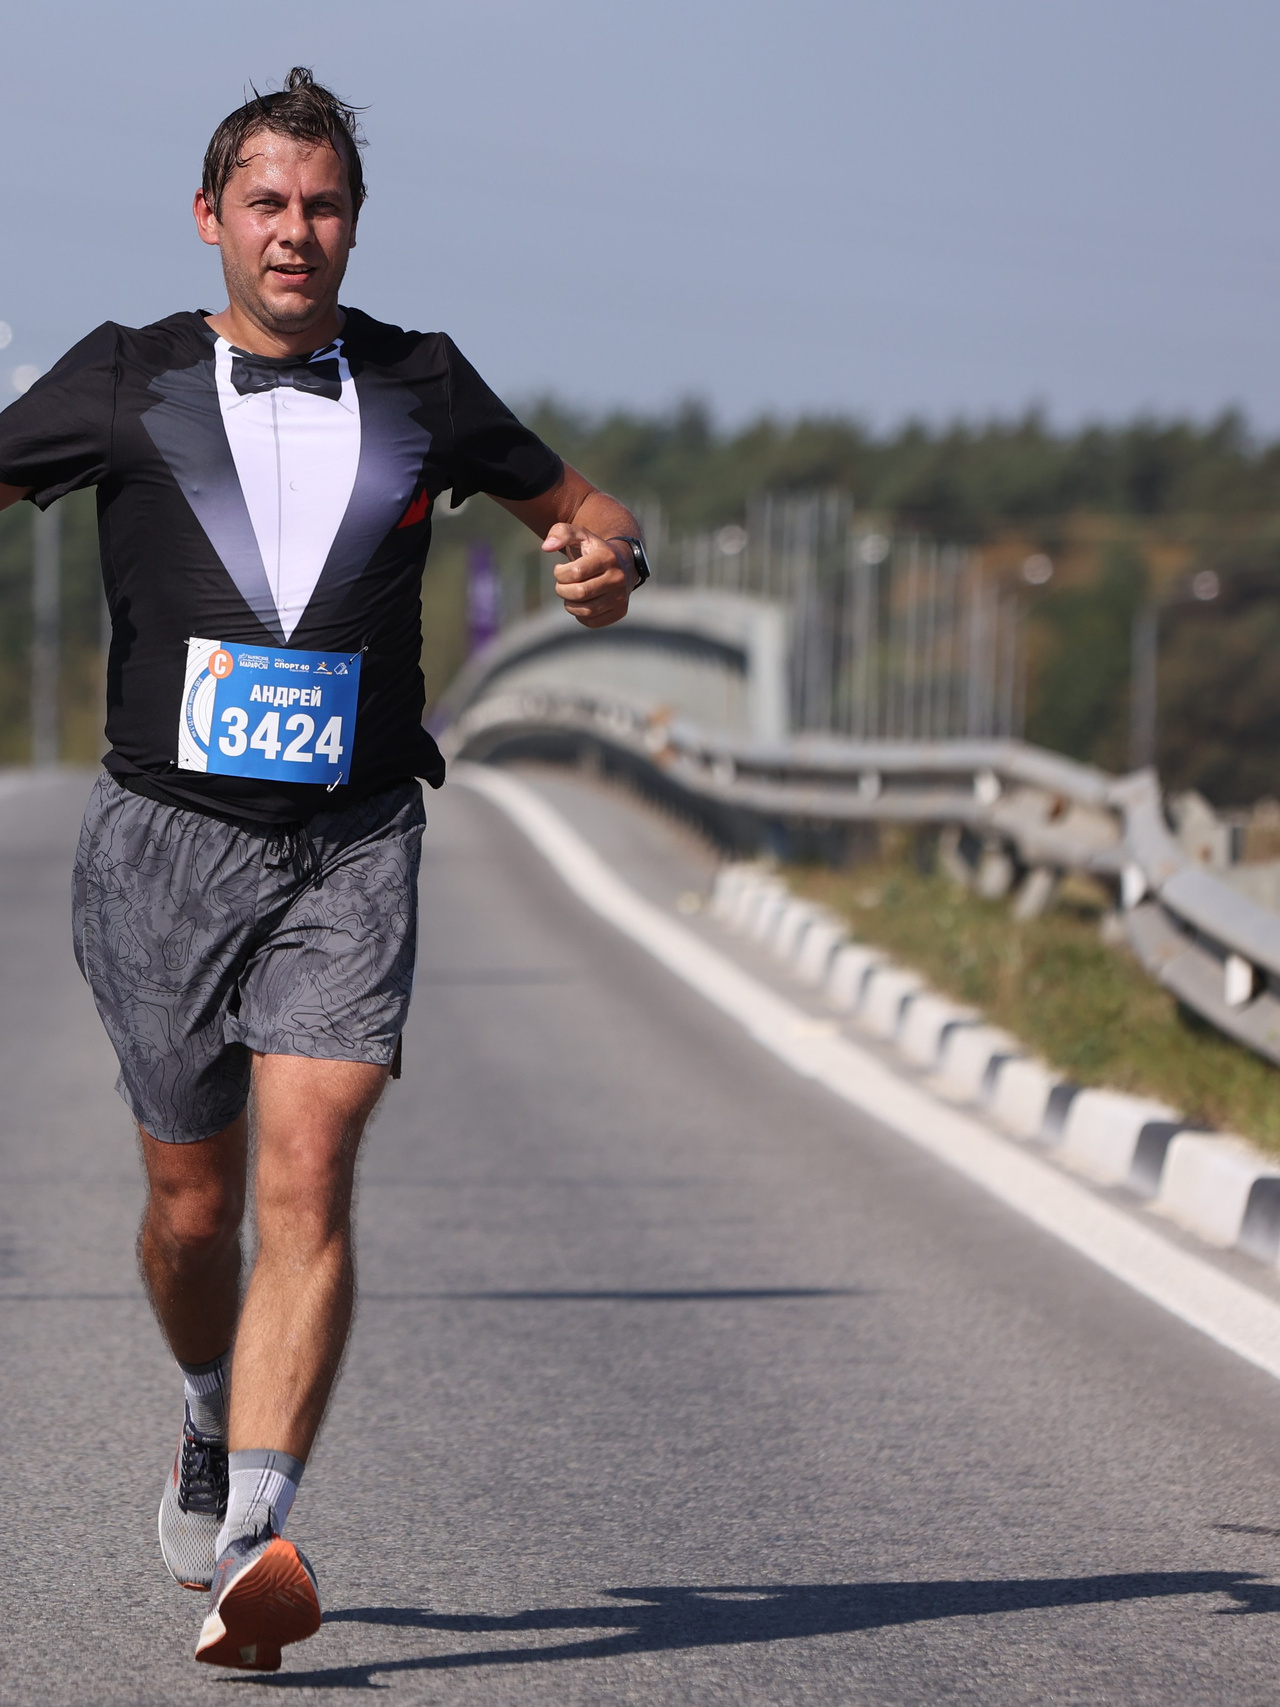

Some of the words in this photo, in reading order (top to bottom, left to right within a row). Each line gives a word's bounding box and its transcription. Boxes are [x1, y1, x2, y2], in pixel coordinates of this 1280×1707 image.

[239, 660, 268, 669] МАРАФОН
[274, 662, 300, 670] СПОРТ
[249, 684, 322, 708] АНДРЕЙ
[218, 706, 344, 764] 3424
